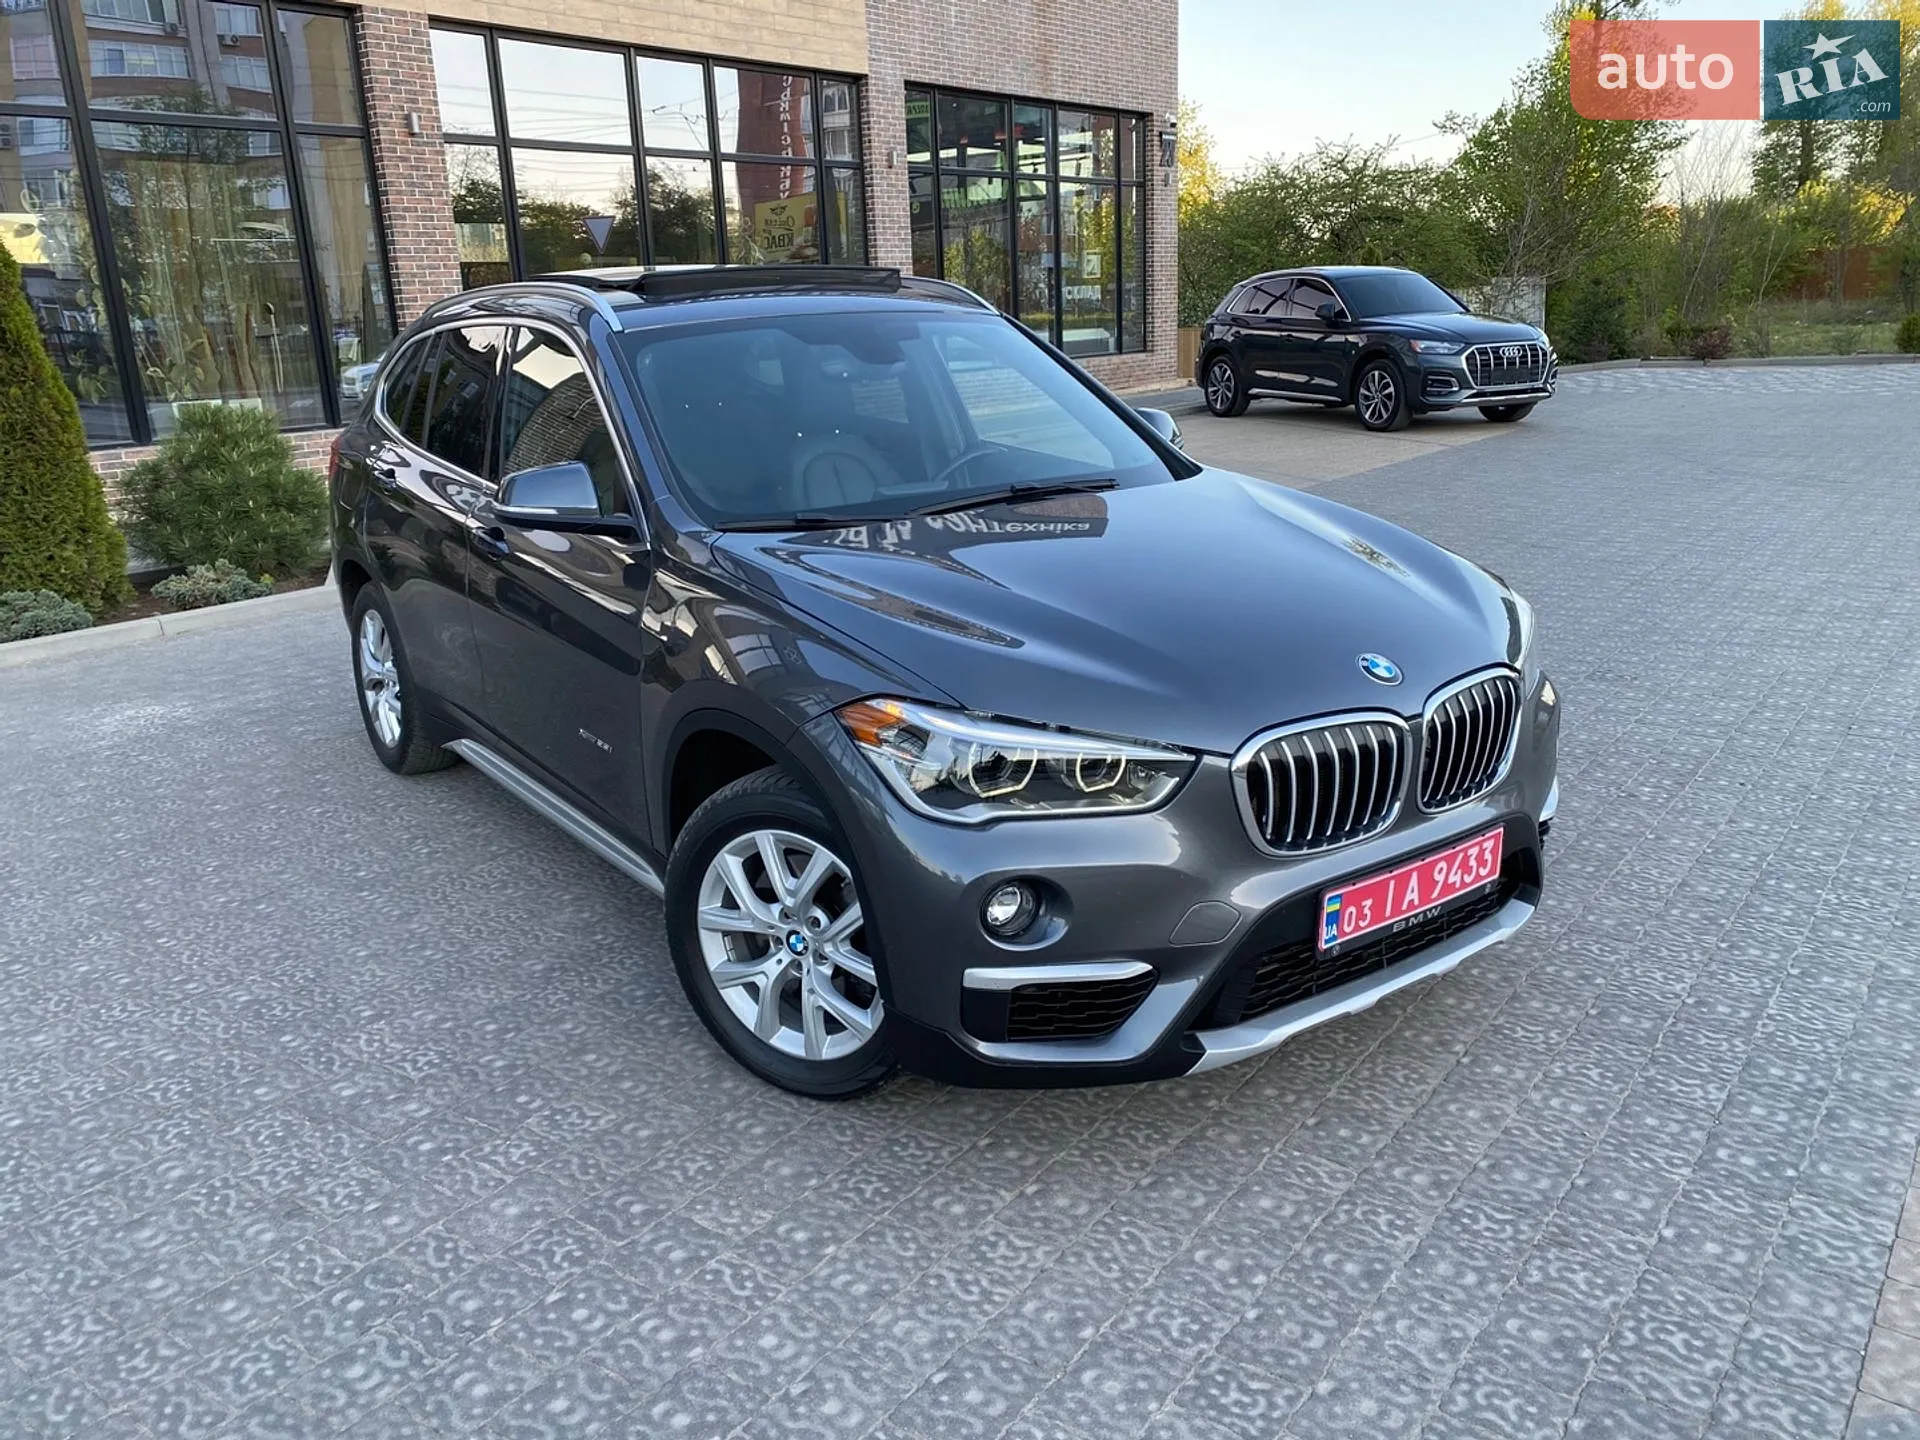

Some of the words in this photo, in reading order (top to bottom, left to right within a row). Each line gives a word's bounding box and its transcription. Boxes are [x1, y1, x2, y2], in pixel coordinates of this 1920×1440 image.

[1325, 923, 1337, 940] UA
[1343, 898, 1373, 933] 03
[1385, 871, 1420, 917] IA
[1431, 839, 1495, 899] 9433
[1393, 906, 1441, 932] BMW
